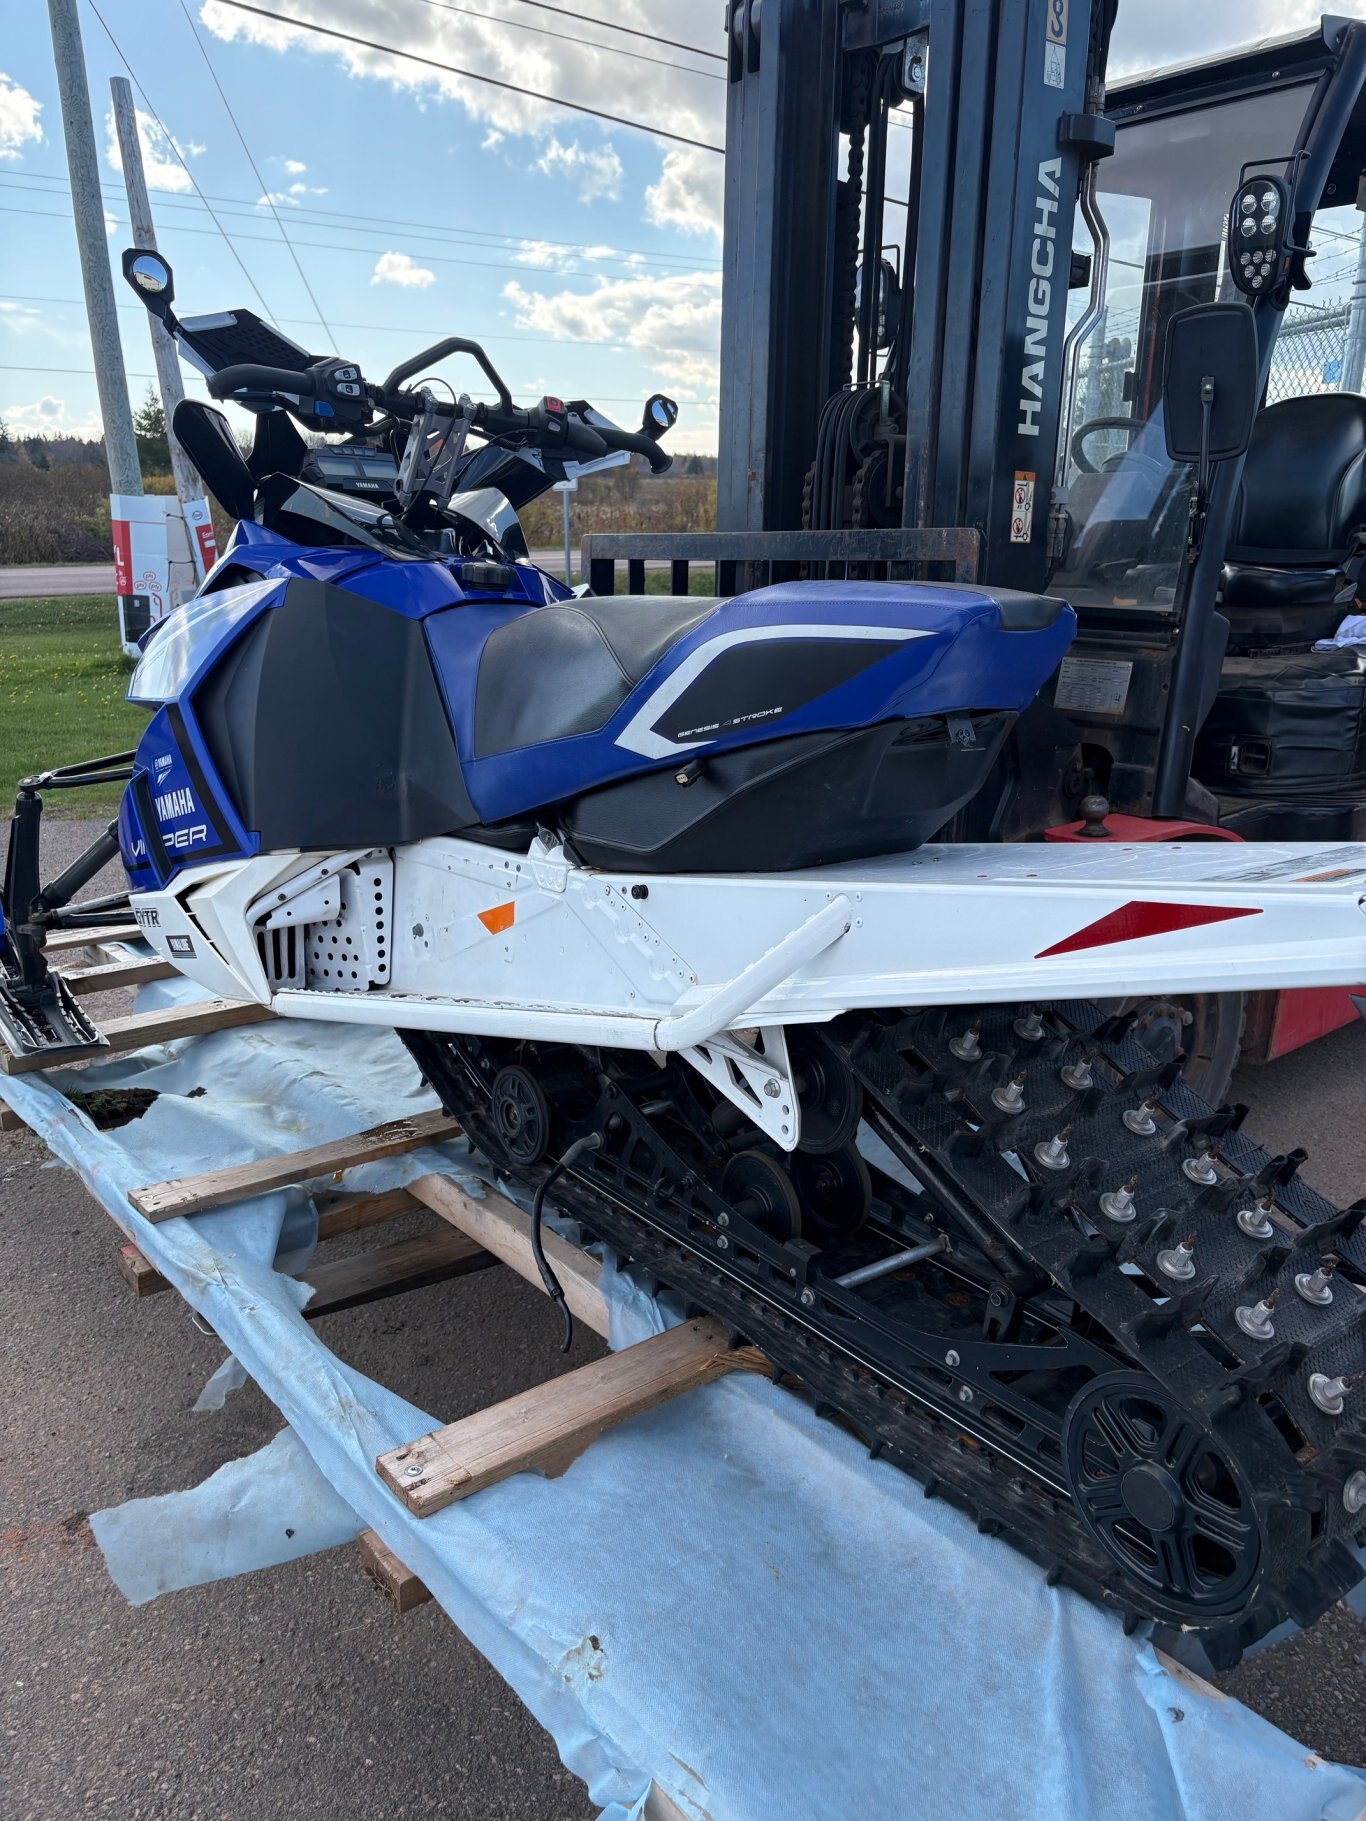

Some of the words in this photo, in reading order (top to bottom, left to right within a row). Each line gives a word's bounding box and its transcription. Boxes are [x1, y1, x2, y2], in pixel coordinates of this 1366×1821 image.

[1018, 157, 1062, 436] HANGCHA
[732, 706, 783, 725] STROKE
[155, 787, 195, 822] YAMAHA
